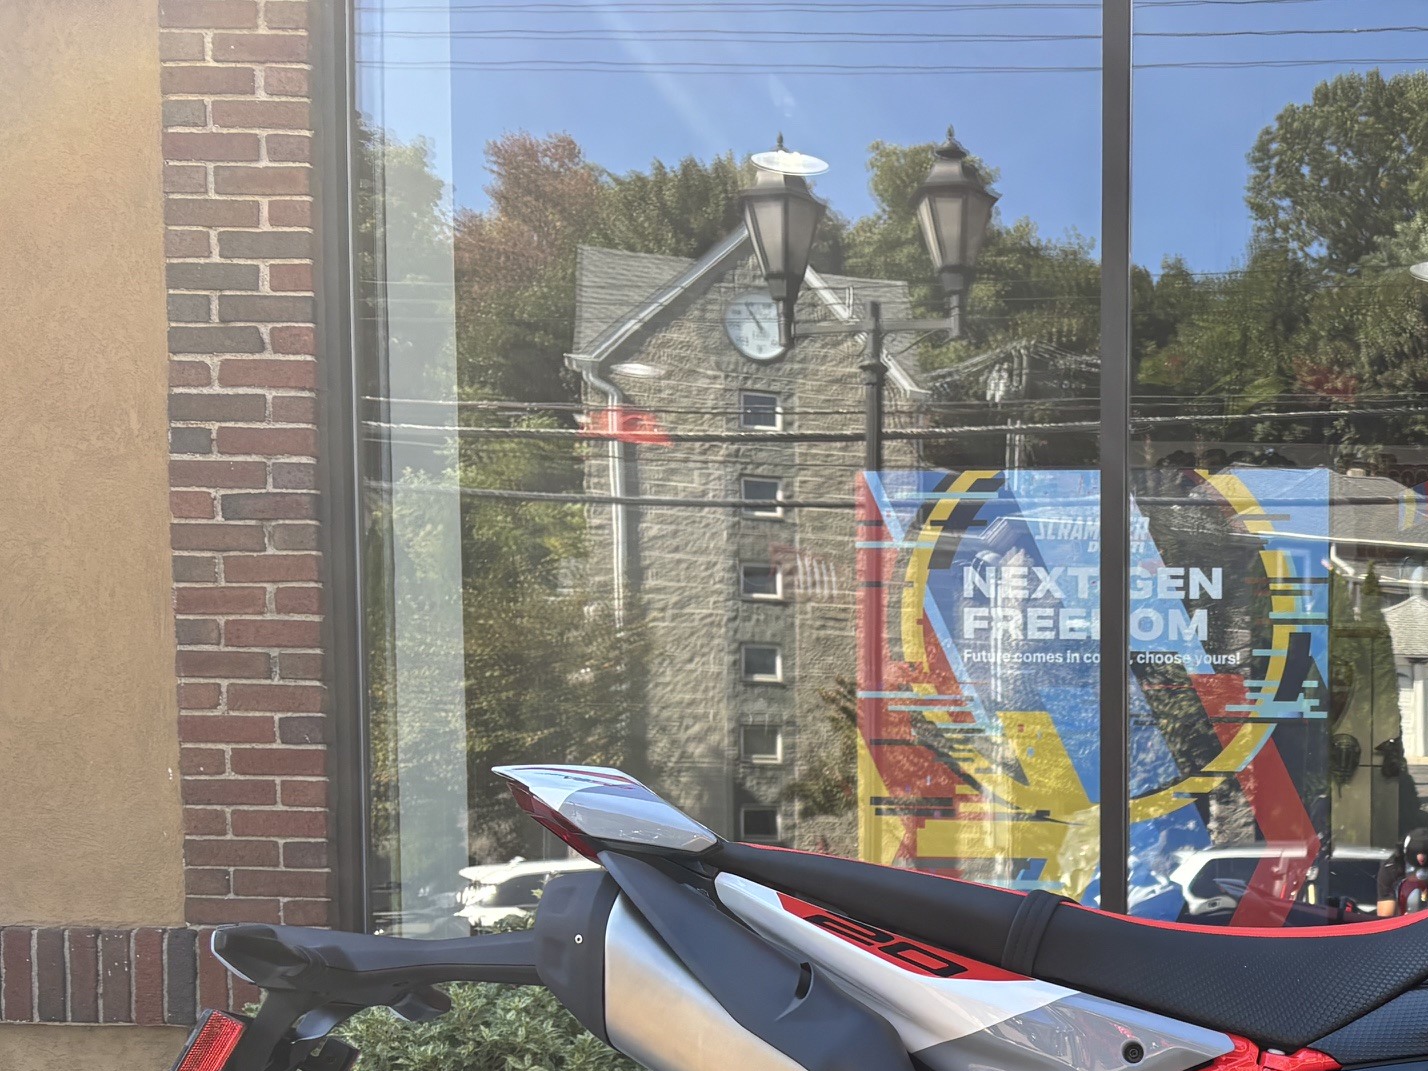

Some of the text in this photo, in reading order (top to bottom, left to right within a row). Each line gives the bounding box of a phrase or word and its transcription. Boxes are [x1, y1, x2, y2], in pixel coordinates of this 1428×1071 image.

[963, 566, 1223, 600] NEXT GEN
[963, 607, 1208, 641] FREEOM
[1012, 652, 1063, 663] comes
[1066, 650, 1080, 663] in
[1136, 652, 1192, 664] choose
[1195, 652, 1241, 667] yours!
